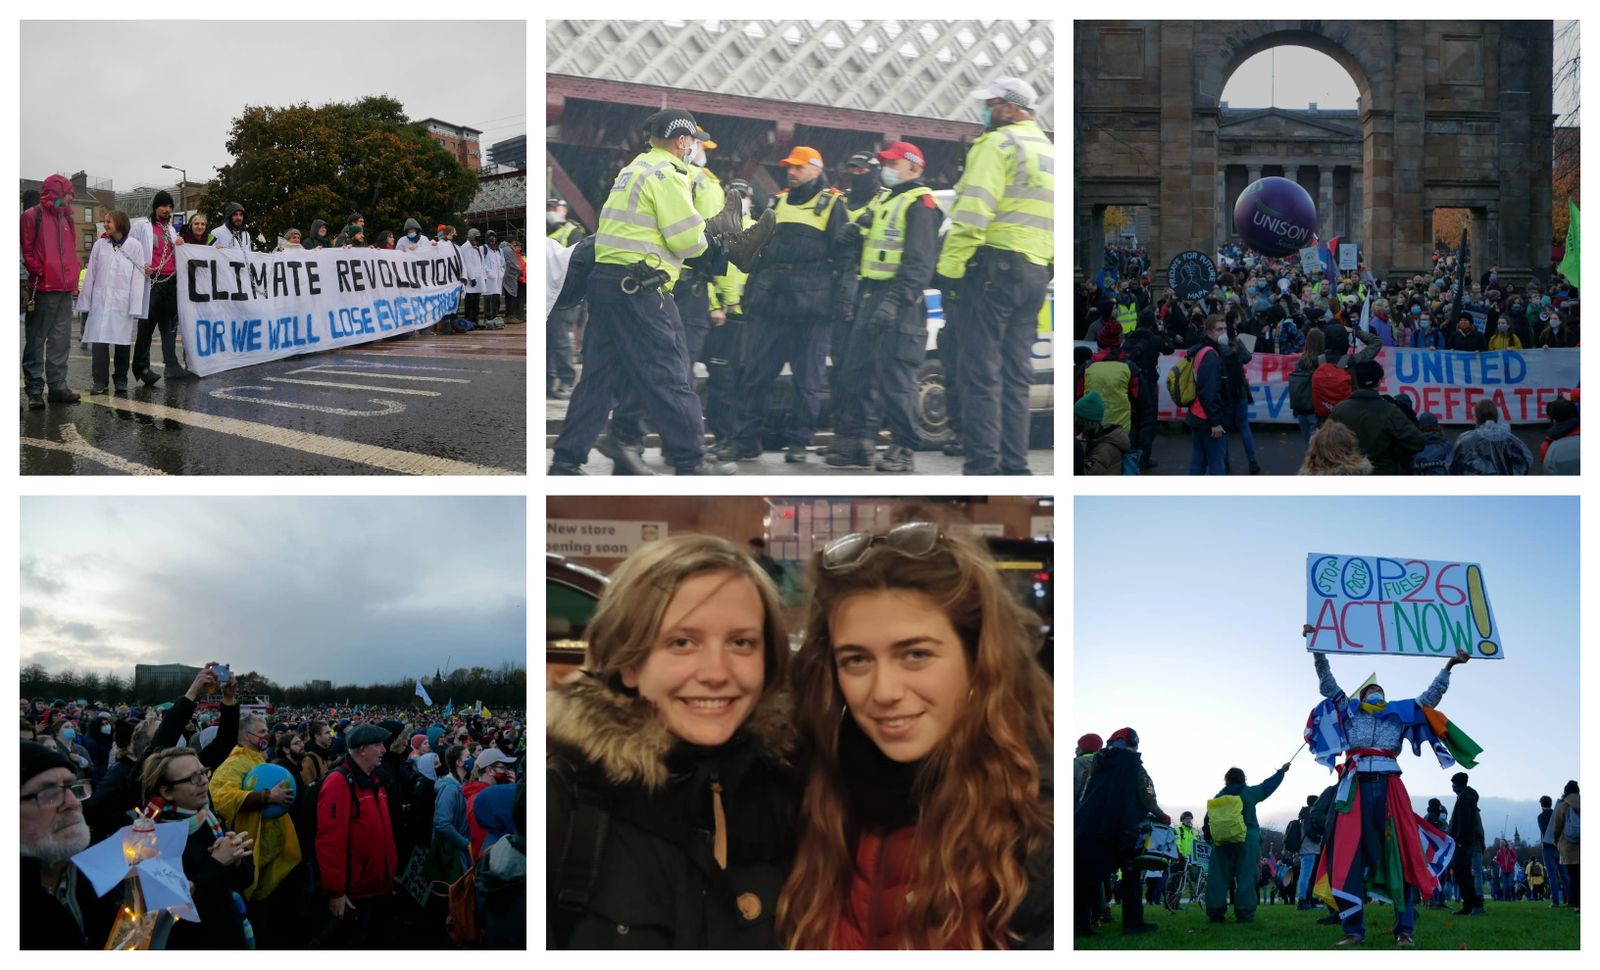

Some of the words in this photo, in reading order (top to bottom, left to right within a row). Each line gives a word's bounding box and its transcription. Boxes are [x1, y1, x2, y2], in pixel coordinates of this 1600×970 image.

[1253, 211, 1309, 241] UNISON
[187, 258, 322, 303] CLIMATE
[1182, 252, 1198, 261] FOR
[1199, 254, 1216, 282] FUTURE
[195, 319, 226, 358] OR
[231, 318, 263, 353] WE
[268, 313, 321, 351] WILL
[328, 306, 376, 340] LOSE
[1395, 351, 1528, 385] UNITED
[547, 523, 578, 535] New
[580, 525, 616, 536] store
[595, 543, 628, 553] soon
[1318, 559, 1341, 593] STOP
[1383, 572, 1425, 599] FUELS
[1309, 598, 1393, 652] ACT
